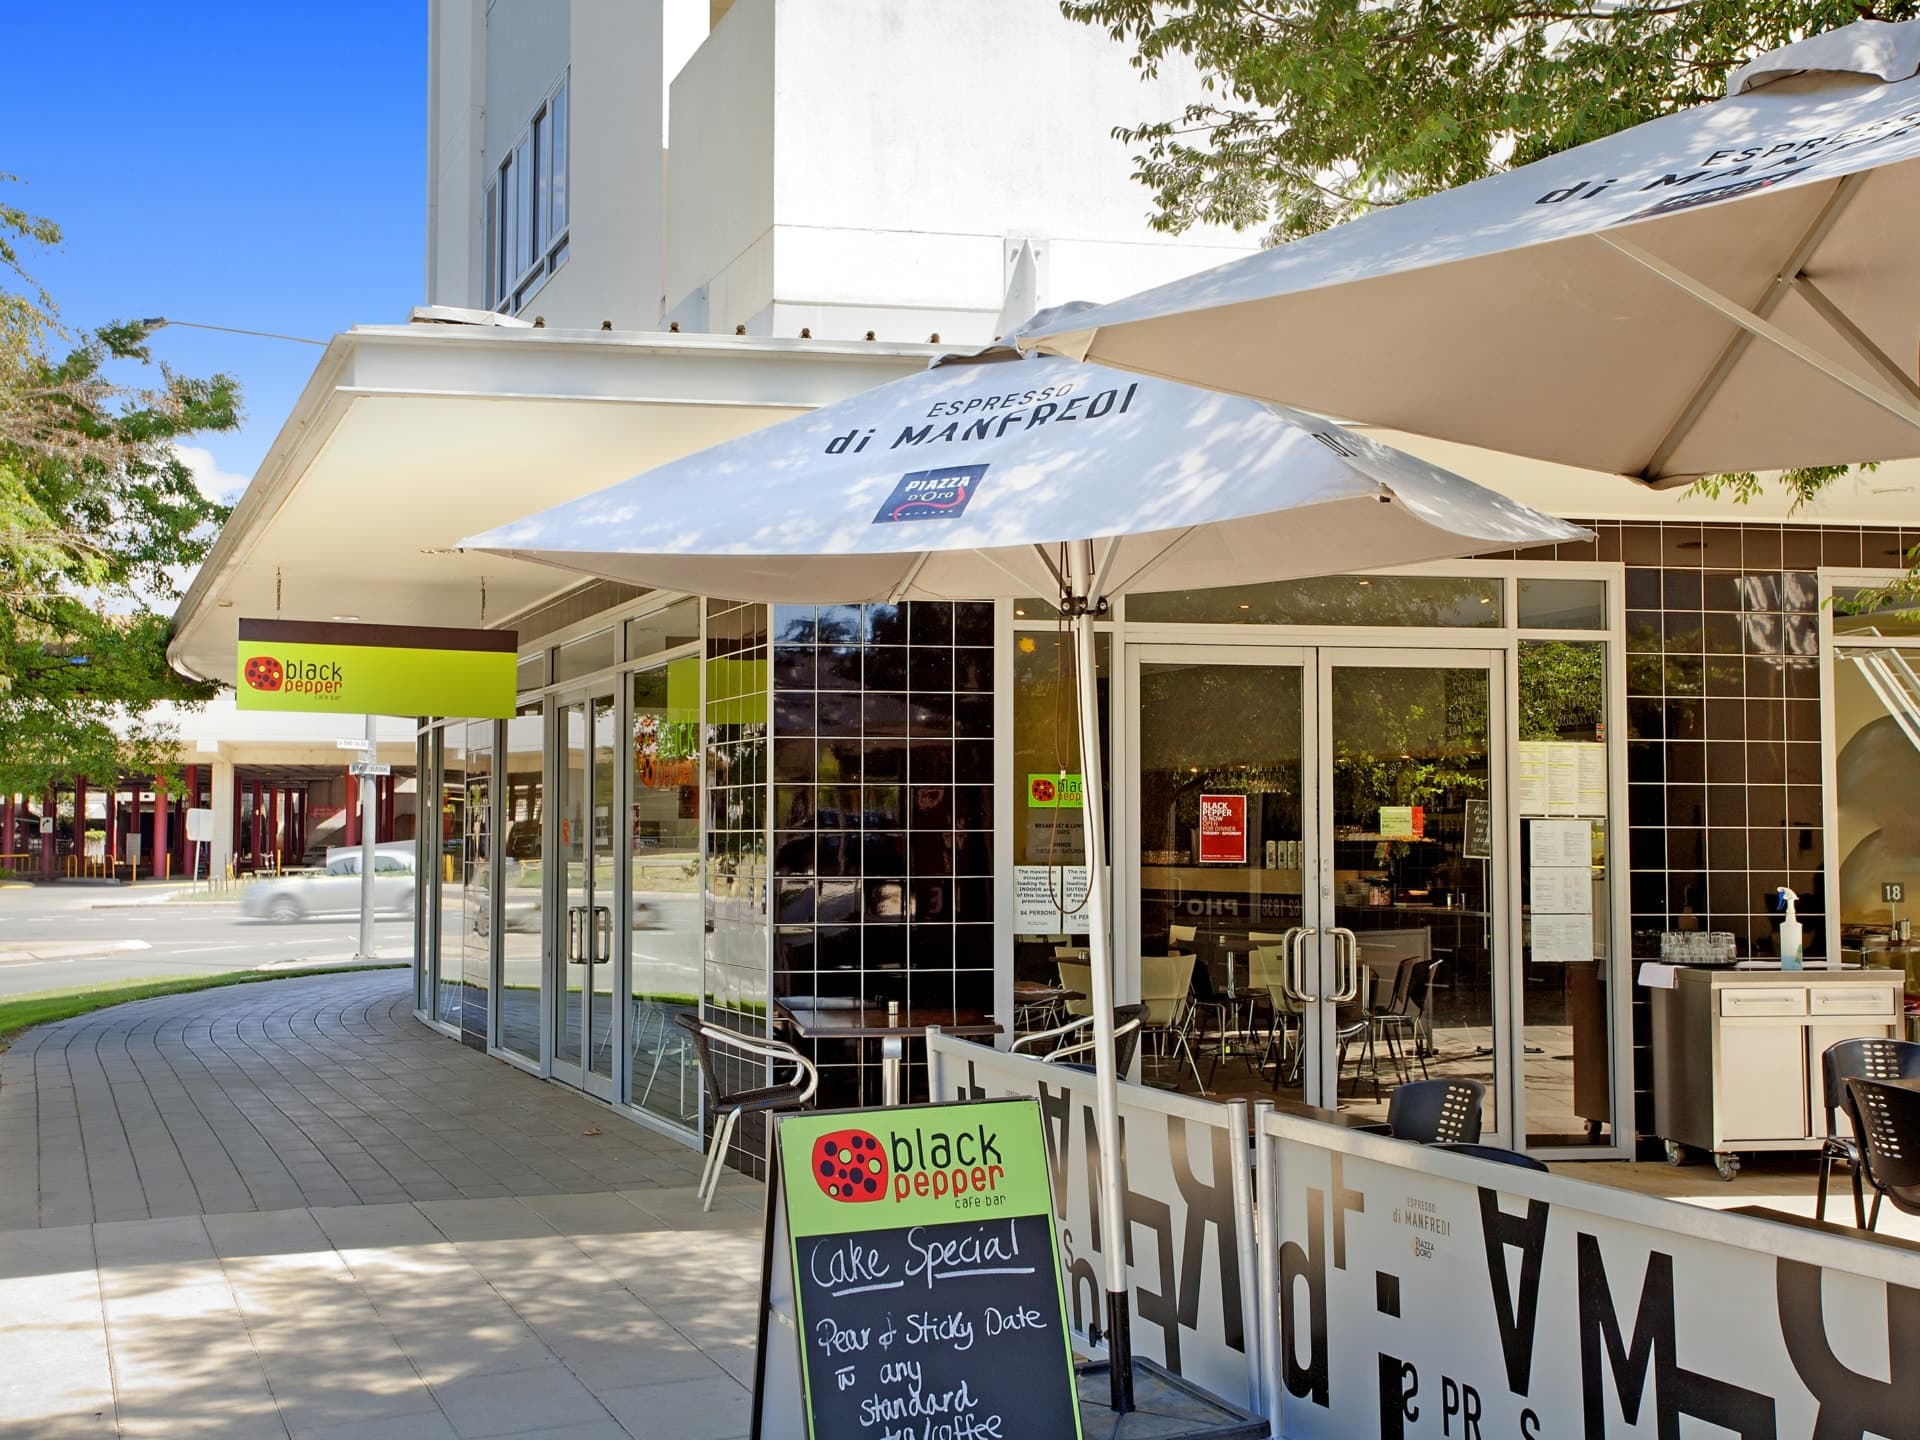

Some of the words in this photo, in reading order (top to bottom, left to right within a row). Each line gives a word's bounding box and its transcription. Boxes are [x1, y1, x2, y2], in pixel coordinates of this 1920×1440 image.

[926, 383, 1074, 418] ESPRESSO
[824, 428, 876, 455] di
[890, 382, 1138, 450] MANFREDI
[904, 475, 971, 492] PIAZZA
[284, 679, 343, 695] pepper
[285, 659, 343, 681] black
[1202, 809, 1233, 817] PEPPER
[1884, 885, 1901, 900] 18
[890, 1124, 1002, 1172] black
[893, 1165, 1005, 1203] pepper
[954, 1196, 981, 1209] cafe
[985, 1194, 1006, 1207] bar
[1404, 1209, 1450, 1237] MANFREDI
[811, 1238, 890, 1288] Cake
[904, 1219, 1020, 1289] Special
[816, 1318, 871, 1356] Pear
[906, 1311, 974, 1350] Sticky
[985, 1305, 1048, 1336] Date
[880, 1360, 922, 1397] any
[859, 1380, 978, 1427] standard
